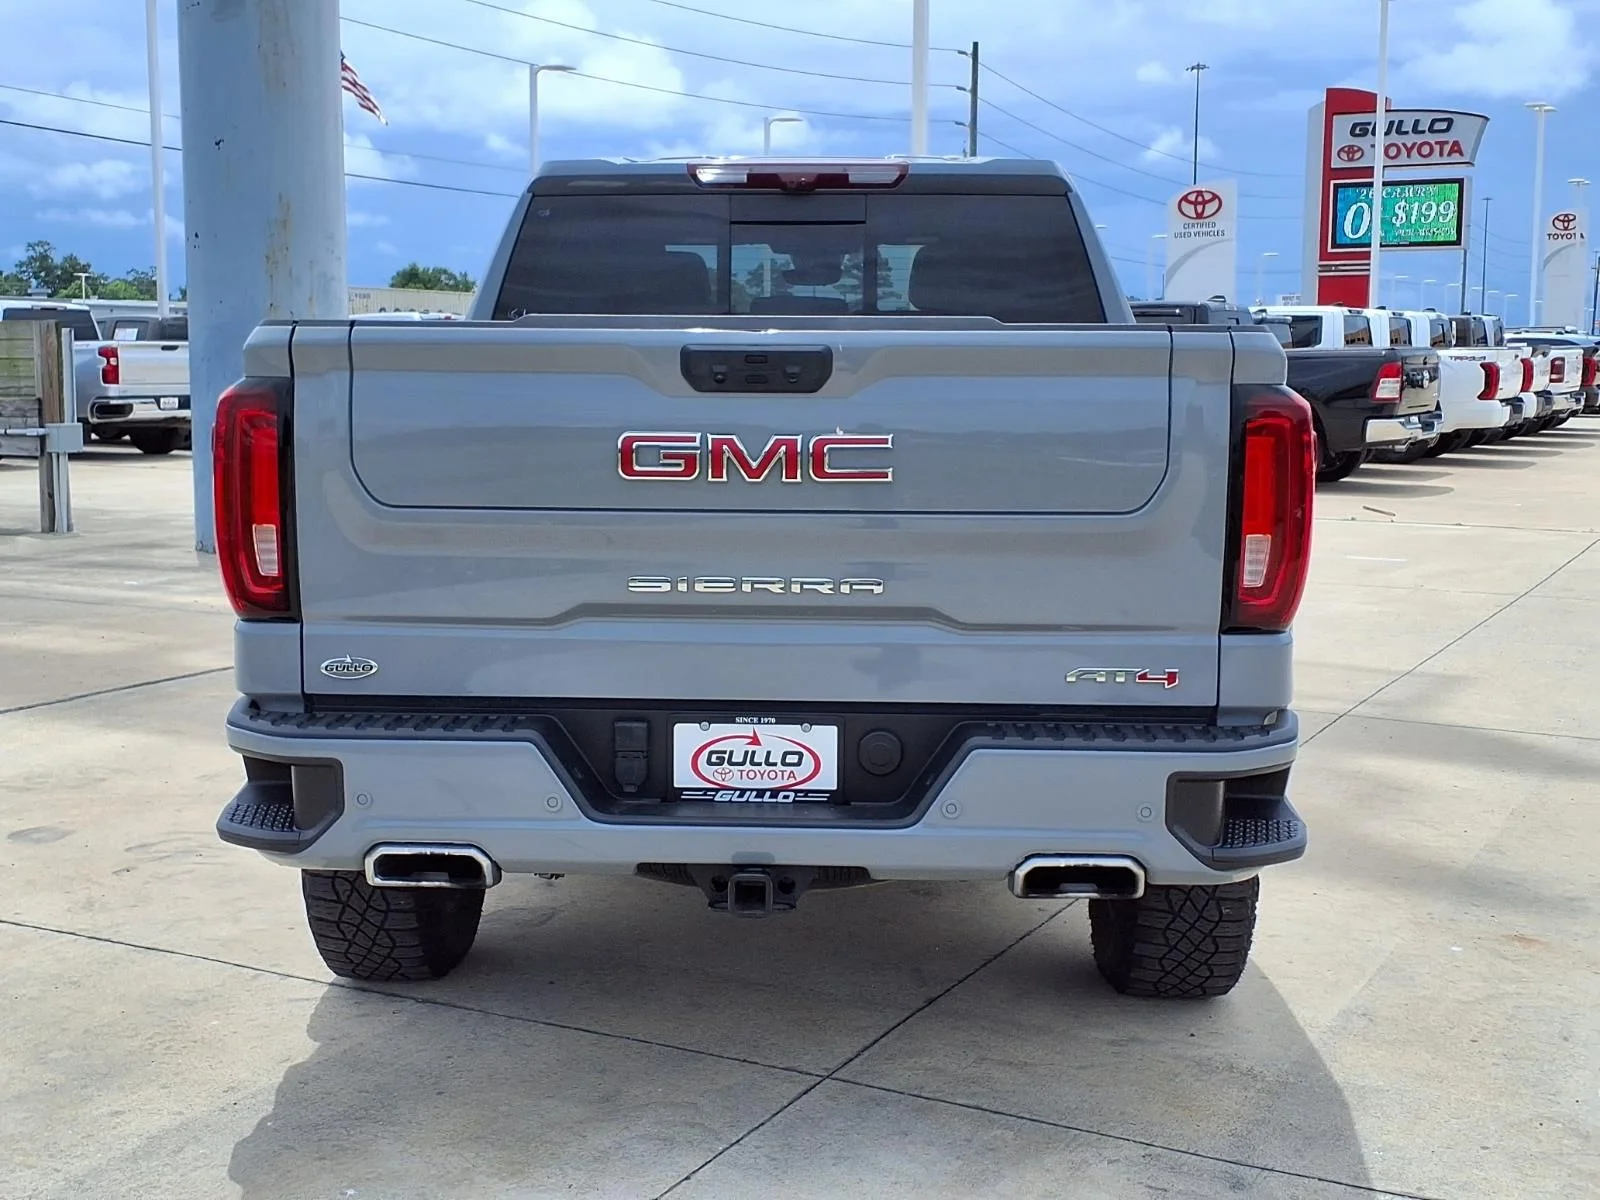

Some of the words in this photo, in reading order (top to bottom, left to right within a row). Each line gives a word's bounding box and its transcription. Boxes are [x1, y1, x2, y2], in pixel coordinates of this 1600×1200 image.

[1349, 117, 1455, 138] GULLO
[1391, 199, 1455, 227] $199
[1182, 221, 1217, 230] CERTIFIED
[1174, 231, 1192, 239] USED
[1193, 229, 1225, 238] VEHICLES
[617, 431, 893, 482] GMC
[627, 576, 884, 595] SIERRA
[324, 663, 374, 673] GULLO
[1065, 667, 1180, 689] AT4
[735, 716, 759, 724] SINCE
[706, 750, 804, 767] GULLO
[737, 769, 797, 781] TOYOTA
[714, 790, 795, 803] GULLO
